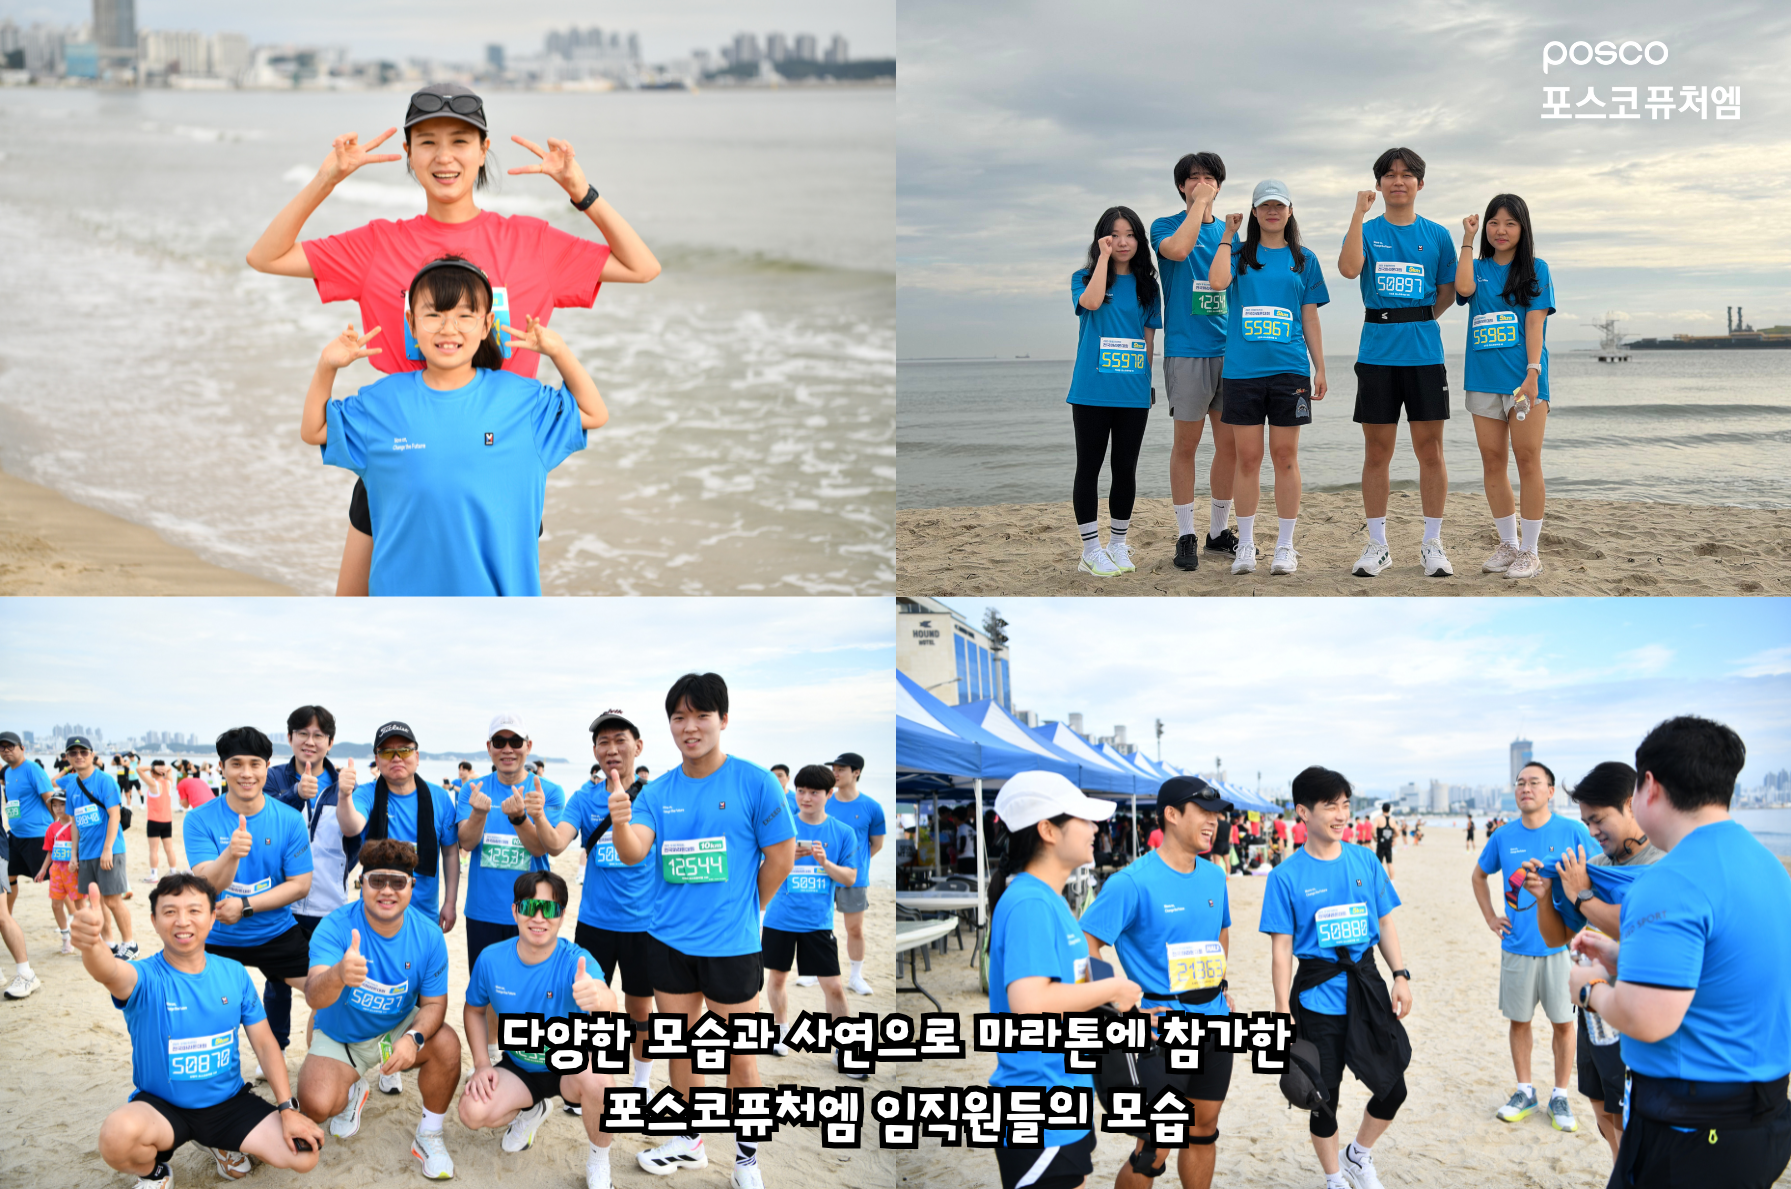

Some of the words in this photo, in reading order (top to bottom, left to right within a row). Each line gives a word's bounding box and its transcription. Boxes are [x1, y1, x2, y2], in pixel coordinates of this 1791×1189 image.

[1377, 276, 1422, 293] 50897
[1245, 320, 1290, 337] 55967
[1473, 326, 1516, 345] 55963
[1102, 352, 1144, 369] 55970
[913, 630, 940, 638] HOUND
[701, 841, 722, 849] 10km
[488, 848, 525, 864] 12531
[668, 856, 722, 876] 12544
[792, 876, 826, 889] 50911
[1637, 910, 1667, 928] SPORT
[1320, 919, 1368, 942] 50880
[1177, 959, 1223, 982] 21363
[351, 989, 403, 1012] 50927
[172, 1048, 231, 1075] 50870
